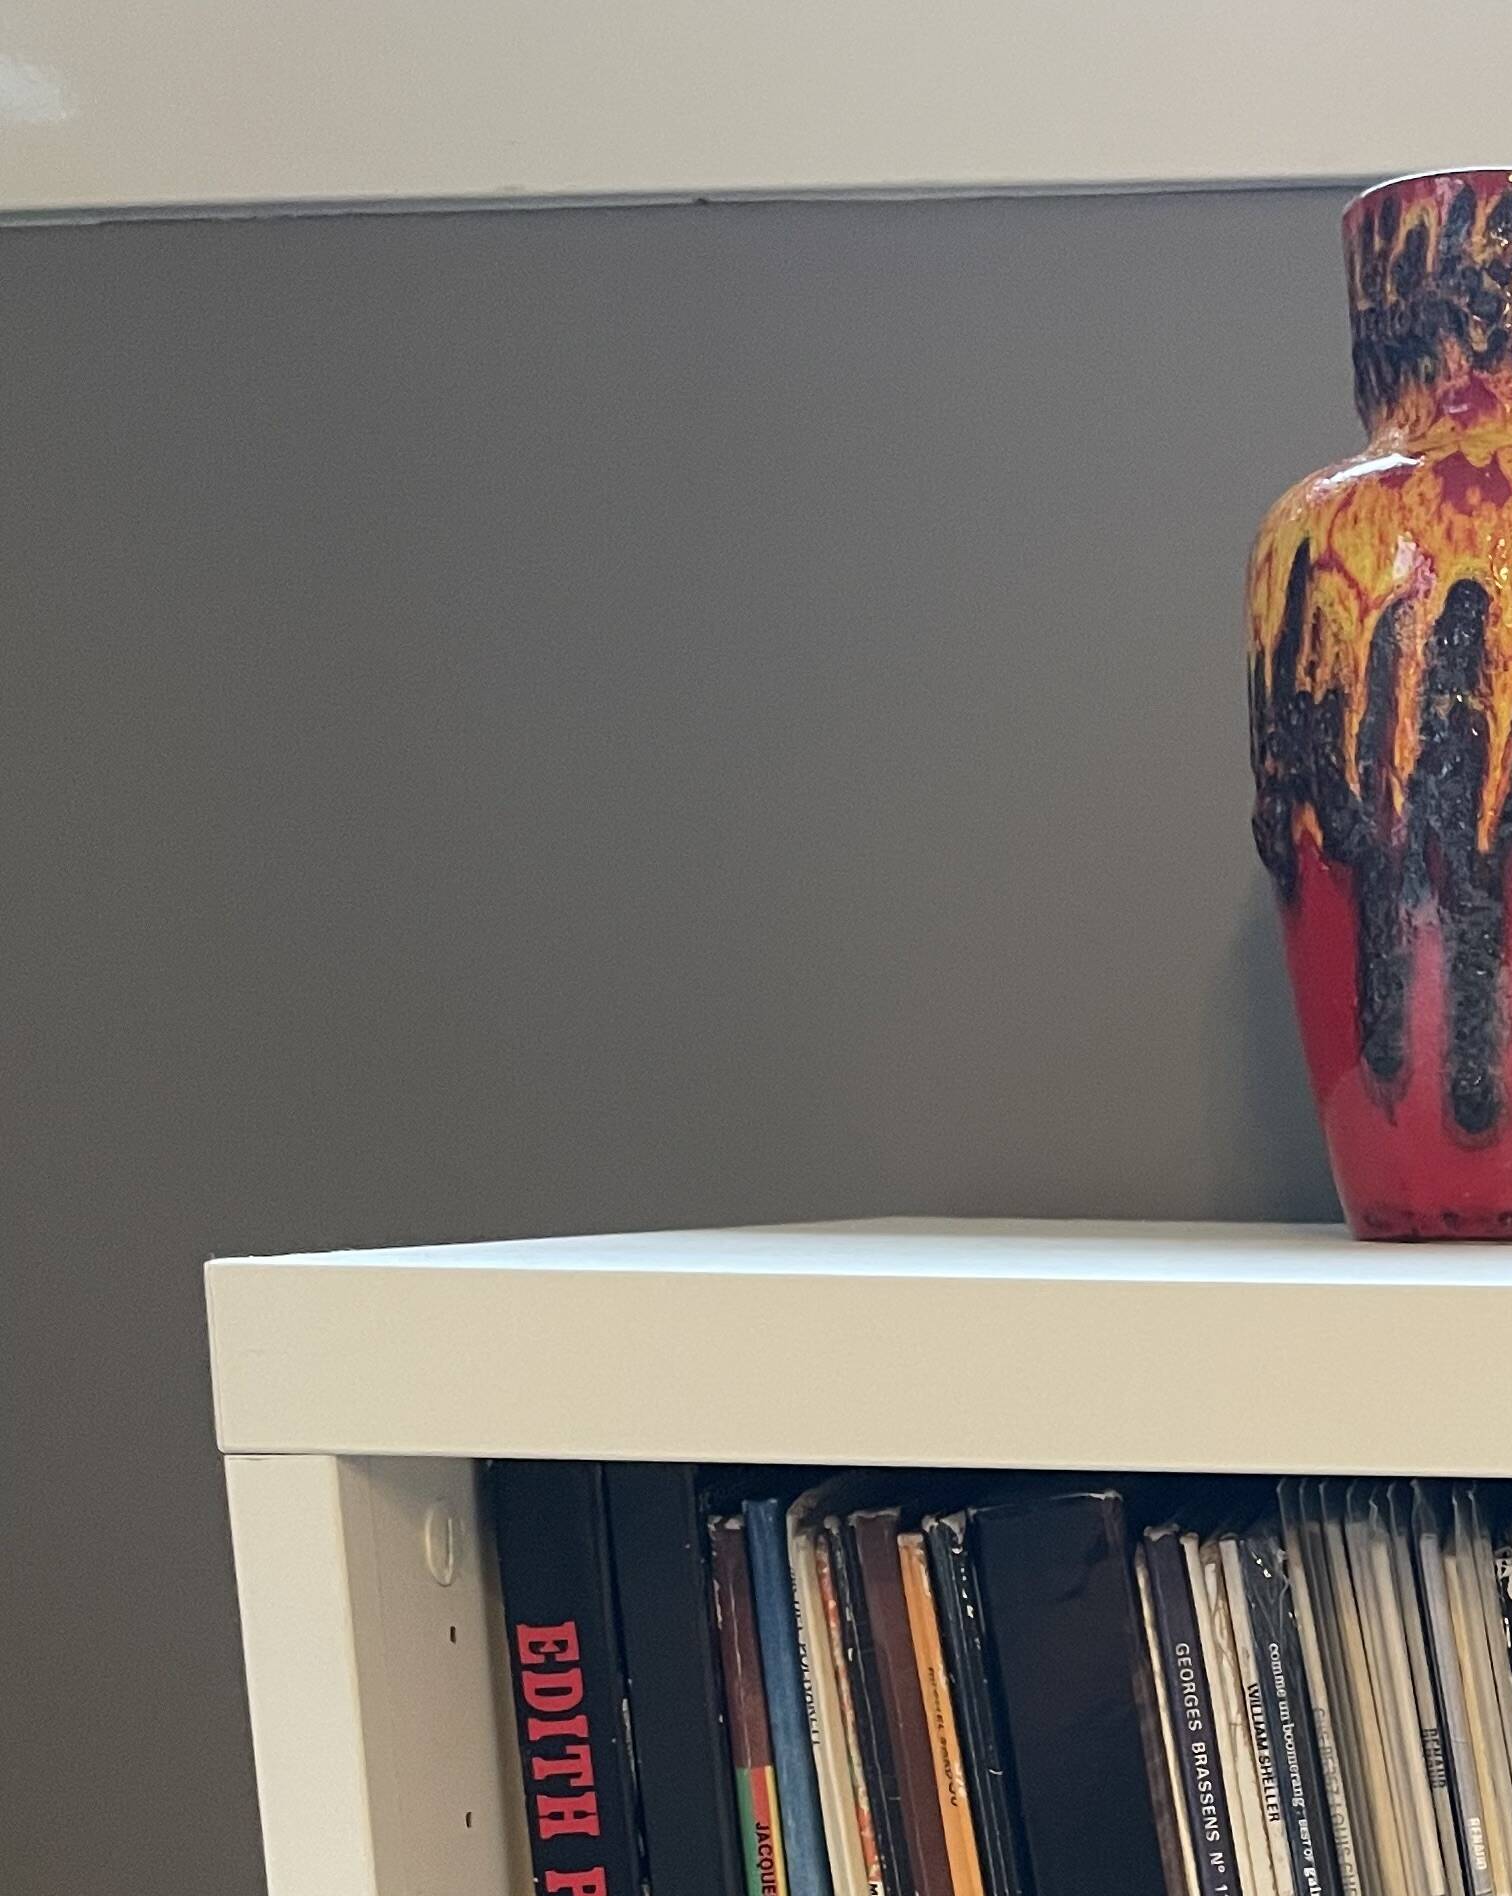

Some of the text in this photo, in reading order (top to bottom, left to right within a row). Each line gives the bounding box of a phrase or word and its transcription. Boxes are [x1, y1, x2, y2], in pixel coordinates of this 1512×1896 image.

[1267, 1642, 1287, 1698] comme
[1277, 1700, 1291, 1720] un
[515, 1618, 600, 1843] EDITH
[1174, 1641, 1202, 1732] GEORGES
[1190, 1741, 1220, 1842] BRASSENS
[1246, 1682, 1280, 1823] WILLIAM SHELLER
[1277, 1723, 1306, 1807] boomerang
[1468, 1816, 1487, 1870] RENAUD
